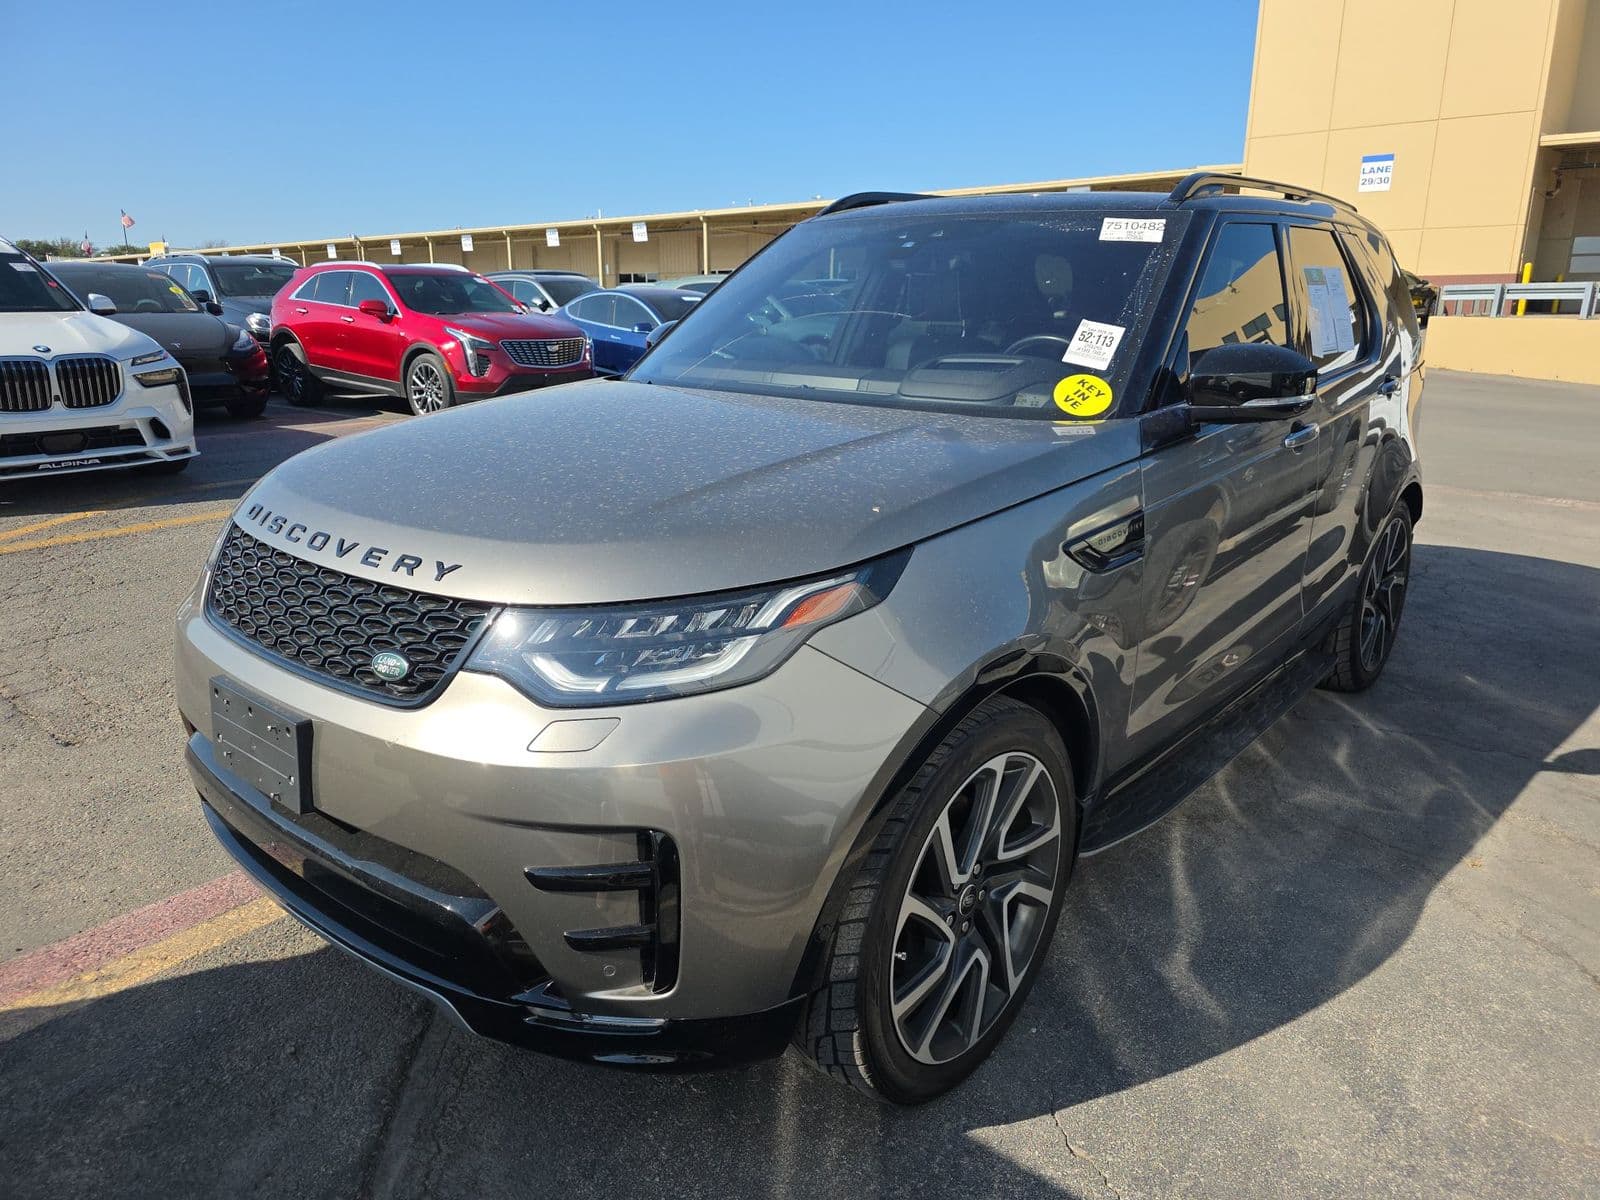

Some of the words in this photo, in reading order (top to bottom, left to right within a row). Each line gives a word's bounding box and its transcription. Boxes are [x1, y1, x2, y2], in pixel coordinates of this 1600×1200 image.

[1362, 165, 1392, 175] LANE
[1360, 176, 1390, 186] 29/30
[1105, 221, 1166, 231] 7510482
[1077, 379, 1106, 398] KEY
[1073, 389, 1090, 402] IN
[1063, 395, 1082, 410] VE
[38, 458, 101, 470] ALPINA
[248, 503, 463, 582] DISCOVERY
[377, 655, 397, 666] LAND
[377, 663, 400, 676] ROVER
